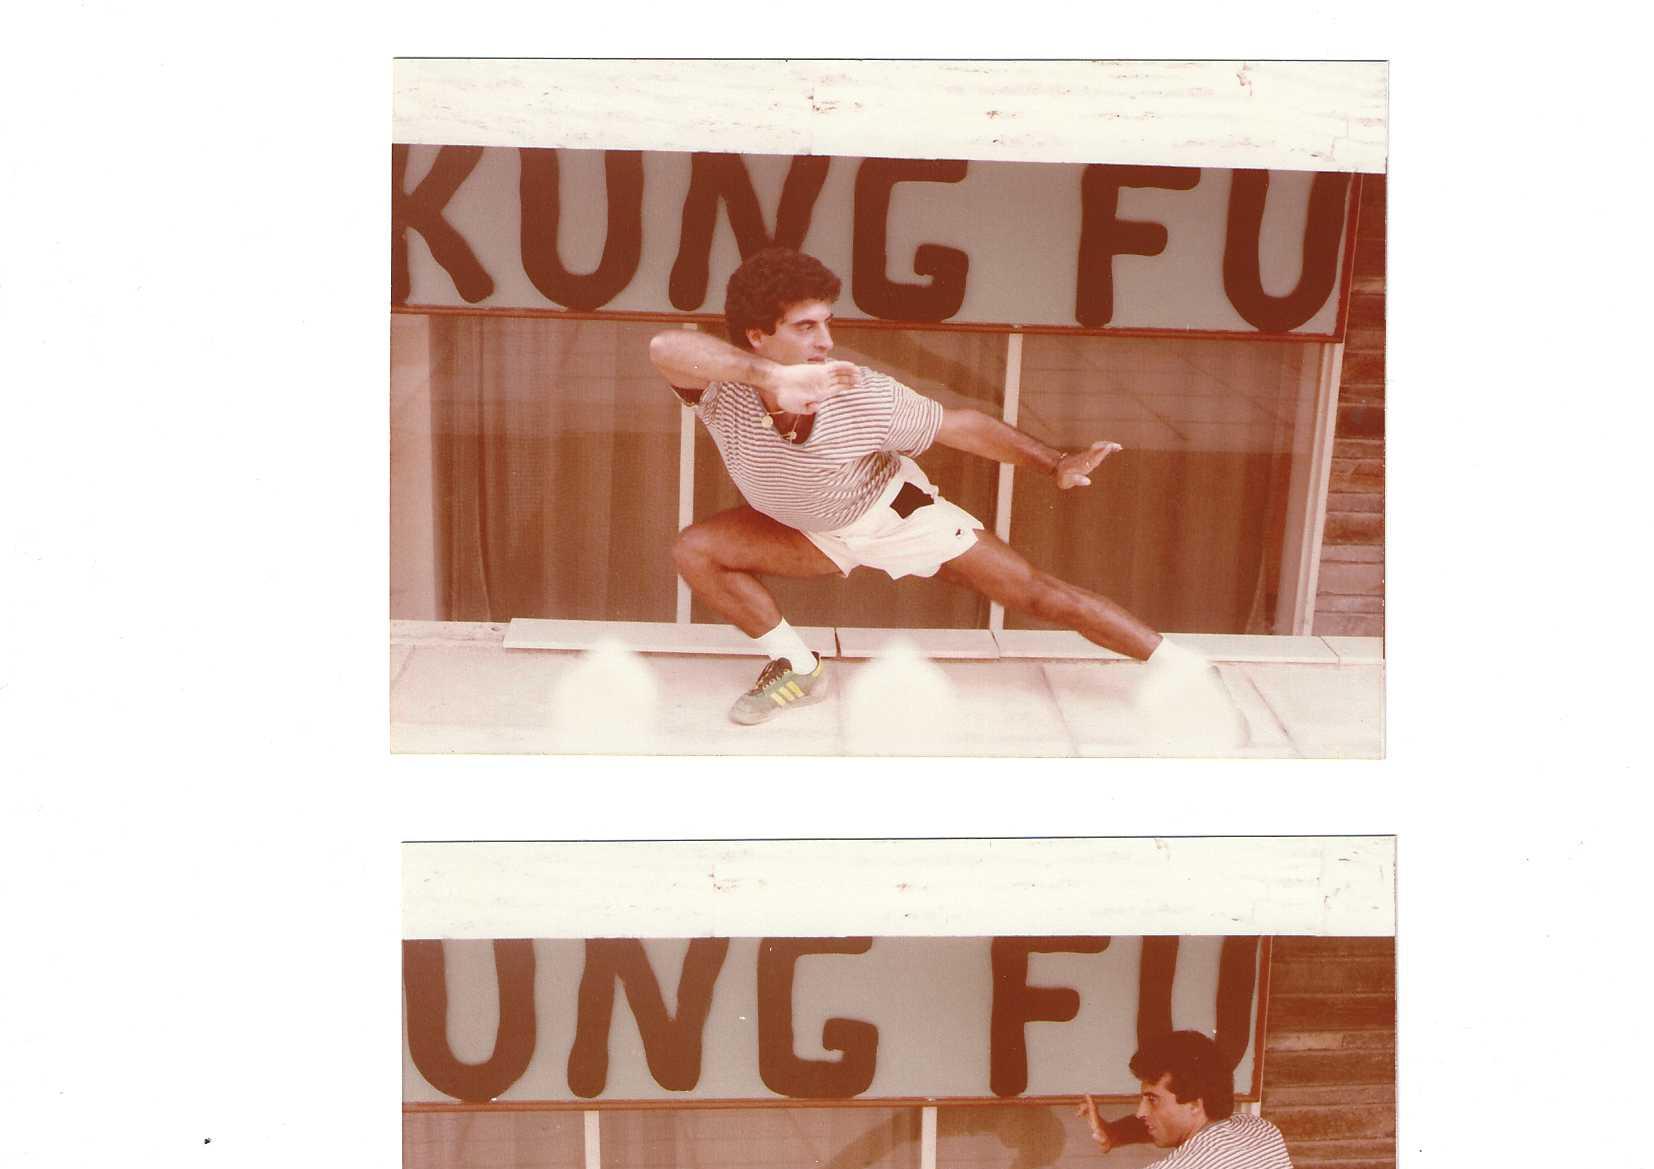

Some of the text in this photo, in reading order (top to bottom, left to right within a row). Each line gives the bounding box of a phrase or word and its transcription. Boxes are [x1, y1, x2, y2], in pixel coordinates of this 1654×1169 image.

[392, 143, 1350, 332] KUNG FU
[402, 936, 1258, 1103] UNG FU
